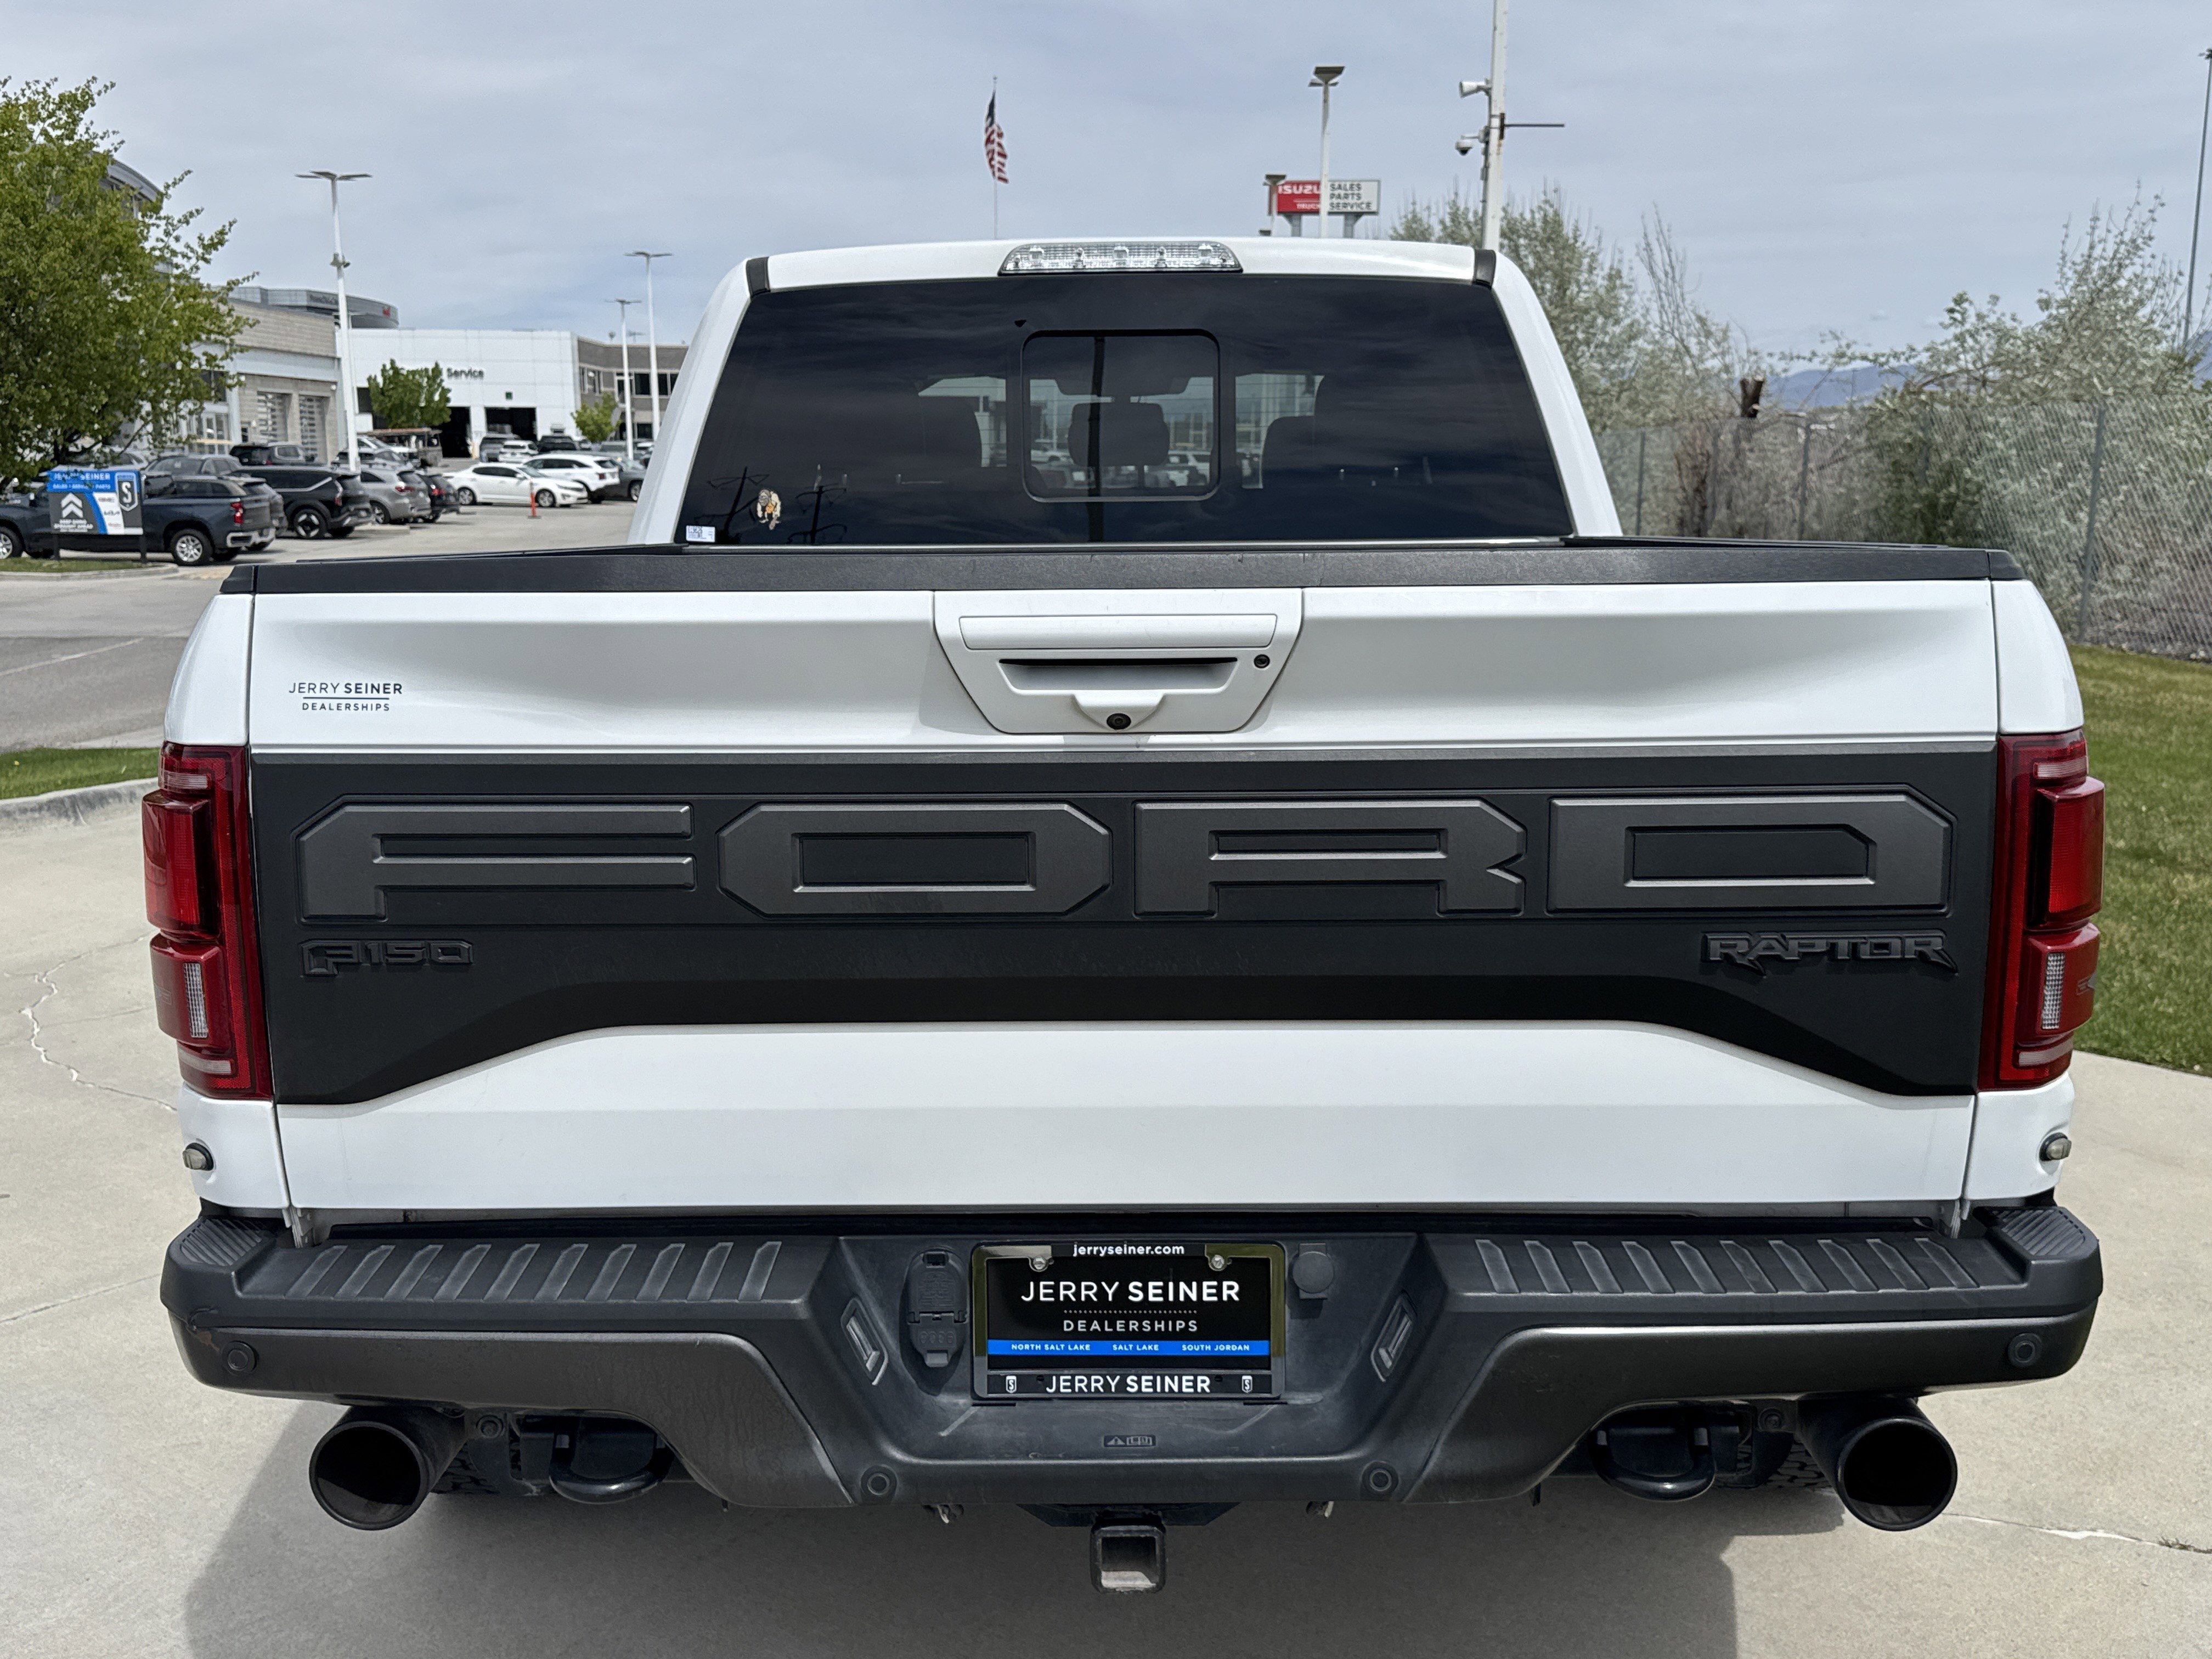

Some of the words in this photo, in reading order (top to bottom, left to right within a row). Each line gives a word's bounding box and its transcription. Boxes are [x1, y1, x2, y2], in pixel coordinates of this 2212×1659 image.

[1278, 184, 1320, 194] ISUZU
[1330, 193, 1362, 201] PARTS
[1329, 202, 1372, 210] SERVICE
[447, 366, 484, 379] Service
[289, 682, 340, 693] JERRY
[344, 682, 402, 695] SEINER
[302, 702, 390, 711] DEALERSHIPS
[298, 794, 1951, 923] FORD
[1702, 931, 1957, 978] RAPTOR
[1072, 1243, 1185, 1257] jerryseiner.com
[1021, 1281, 1119, 1302] JERRY
[1128, 1281, 1240, 1302] SEINER
[1063, 1320, 1198, 1332] DEALERSHIPS
[1046, 1375, 1120, 1392] JERRY
[1126, 1375, 1210, 1393] SEINER
